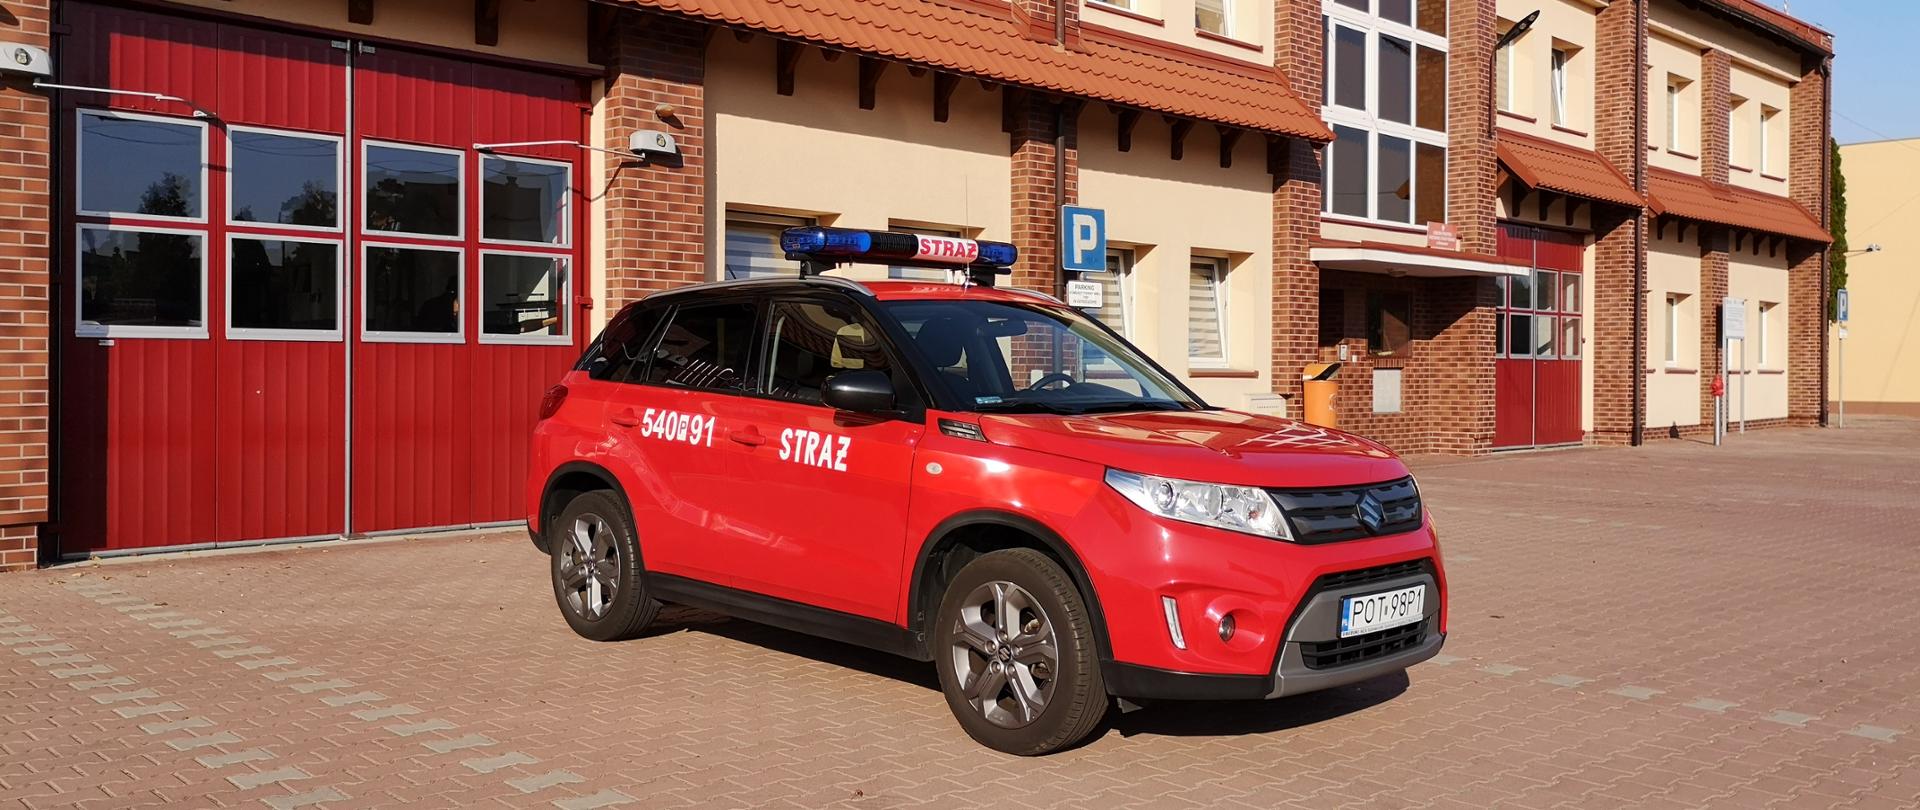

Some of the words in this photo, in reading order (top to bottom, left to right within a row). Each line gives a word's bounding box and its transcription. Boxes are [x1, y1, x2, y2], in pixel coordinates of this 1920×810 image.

[1073, 213, 1097, 264] P
[1352, 596, 1386, 627] POT
[1390, 588, 1422, 619] 98P1
